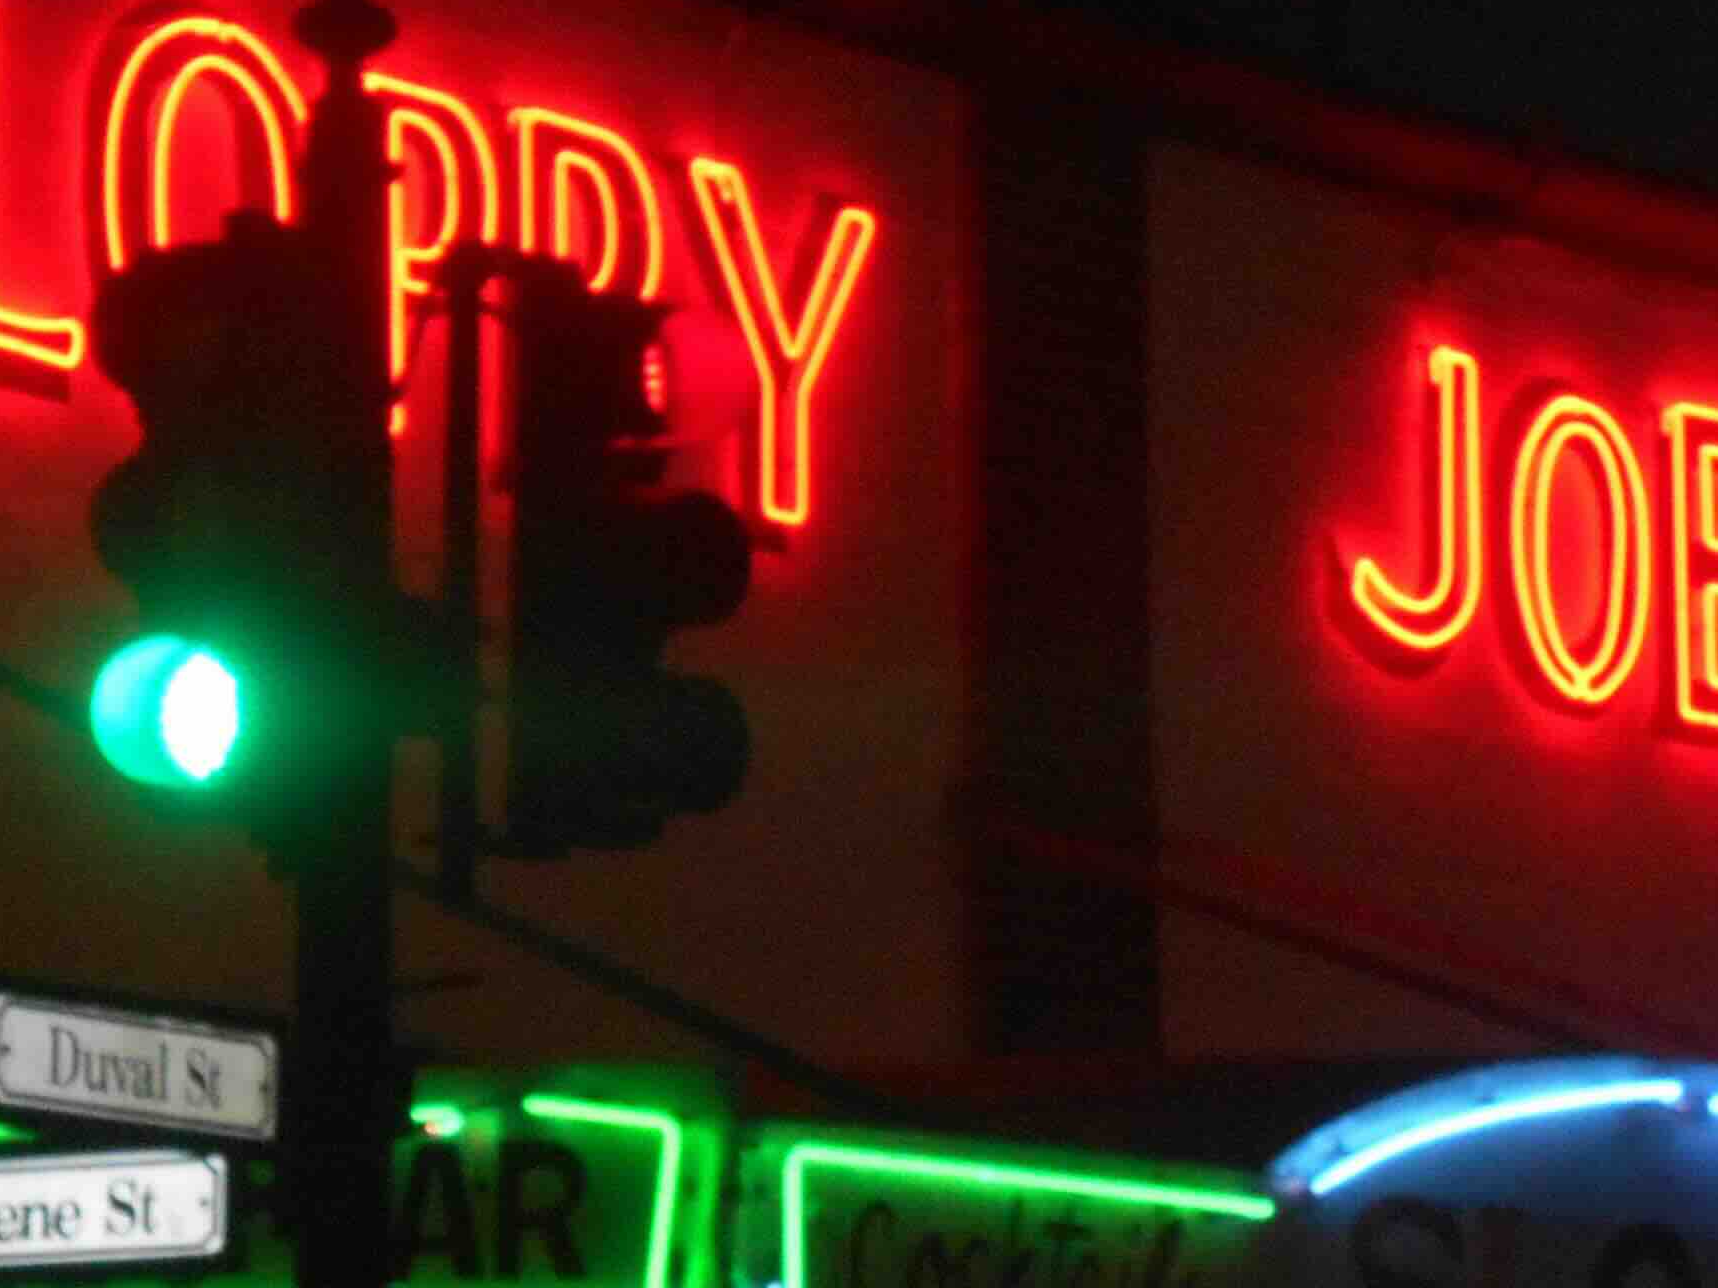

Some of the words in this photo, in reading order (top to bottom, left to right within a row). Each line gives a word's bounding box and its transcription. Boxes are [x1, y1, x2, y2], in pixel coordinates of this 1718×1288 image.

[49, 1025, 169, 1102] Duval
[185, 1048, 221, 1110] St
[104, 1178, 157, 1237] St
